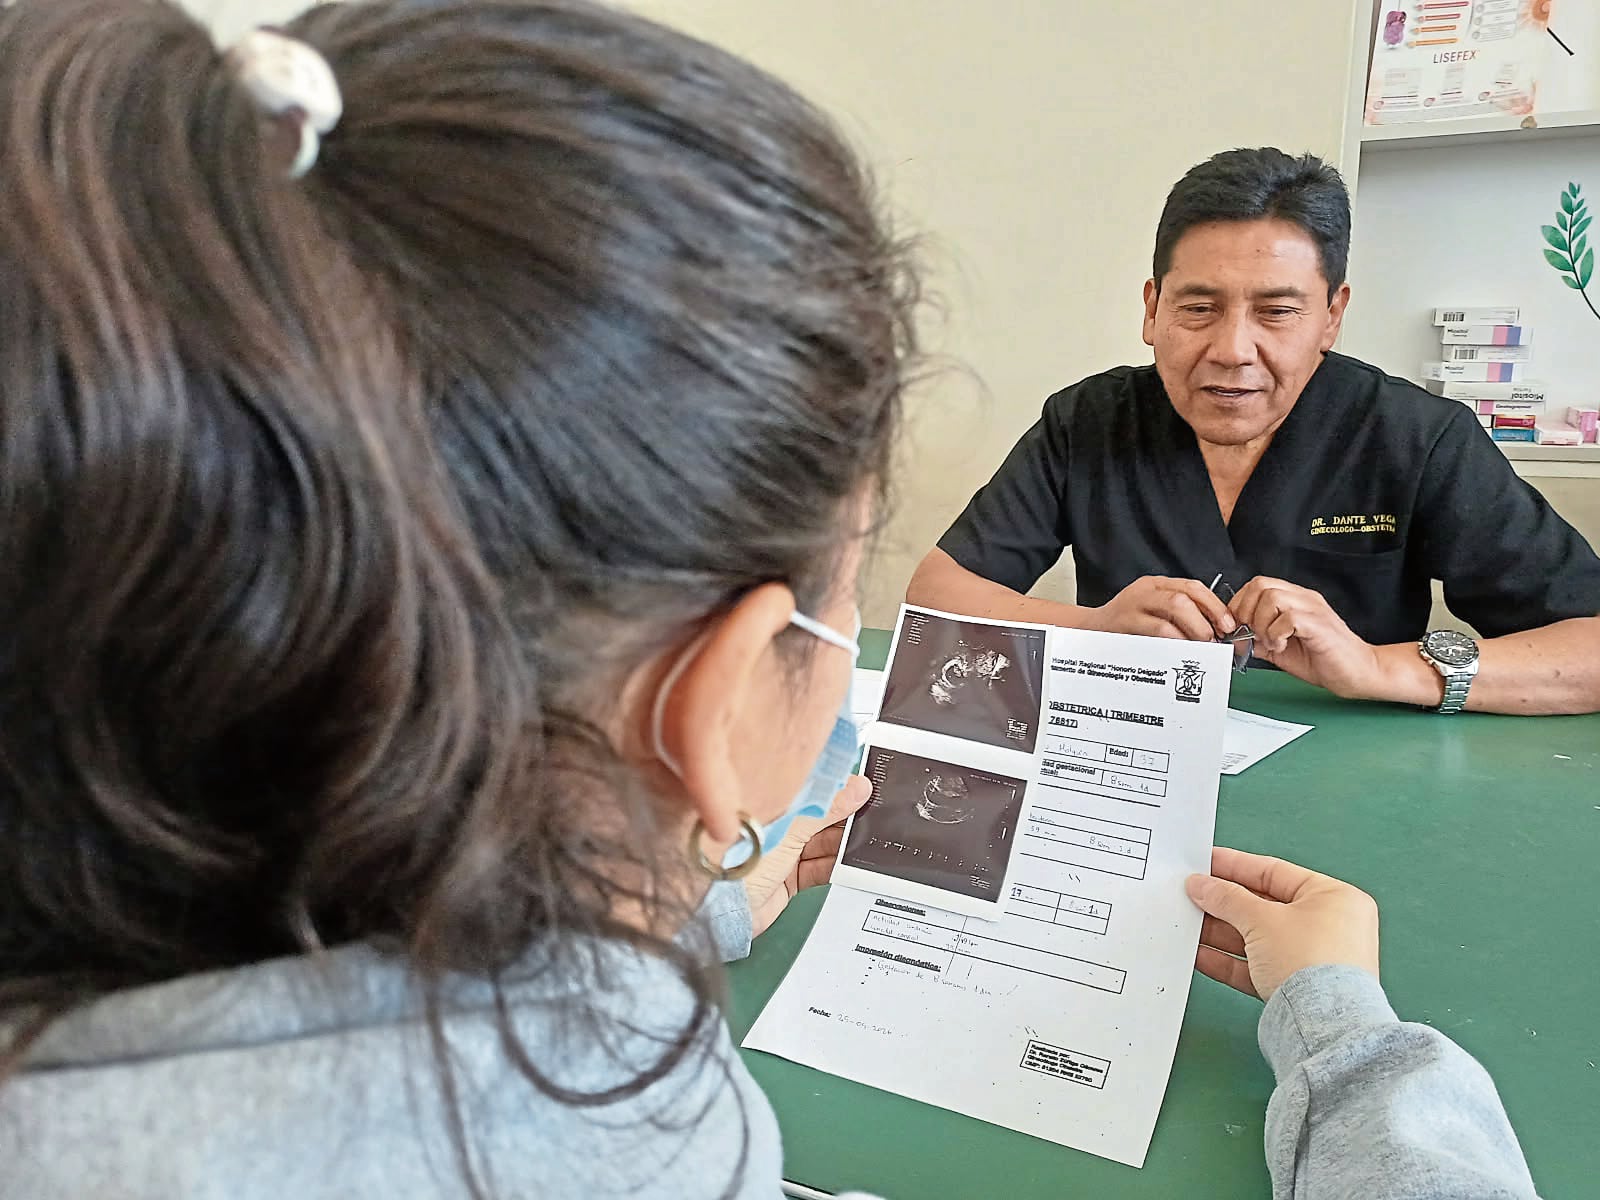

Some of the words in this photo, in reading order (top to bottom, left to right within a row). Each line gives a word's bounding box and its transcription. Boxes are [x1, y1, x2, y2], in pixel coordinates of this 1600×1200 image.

[1433, 50, 1477, 64] LISEFEX
[1311, 518, 1326, 527] DR.
[1333, 515, 1366, 525] DANTE
[1110, 709, 1165, 727] TRIMESTRE
[1109, 747, 1129, 758] Edad:
[1055, 762, 1096, 776] gestacional
